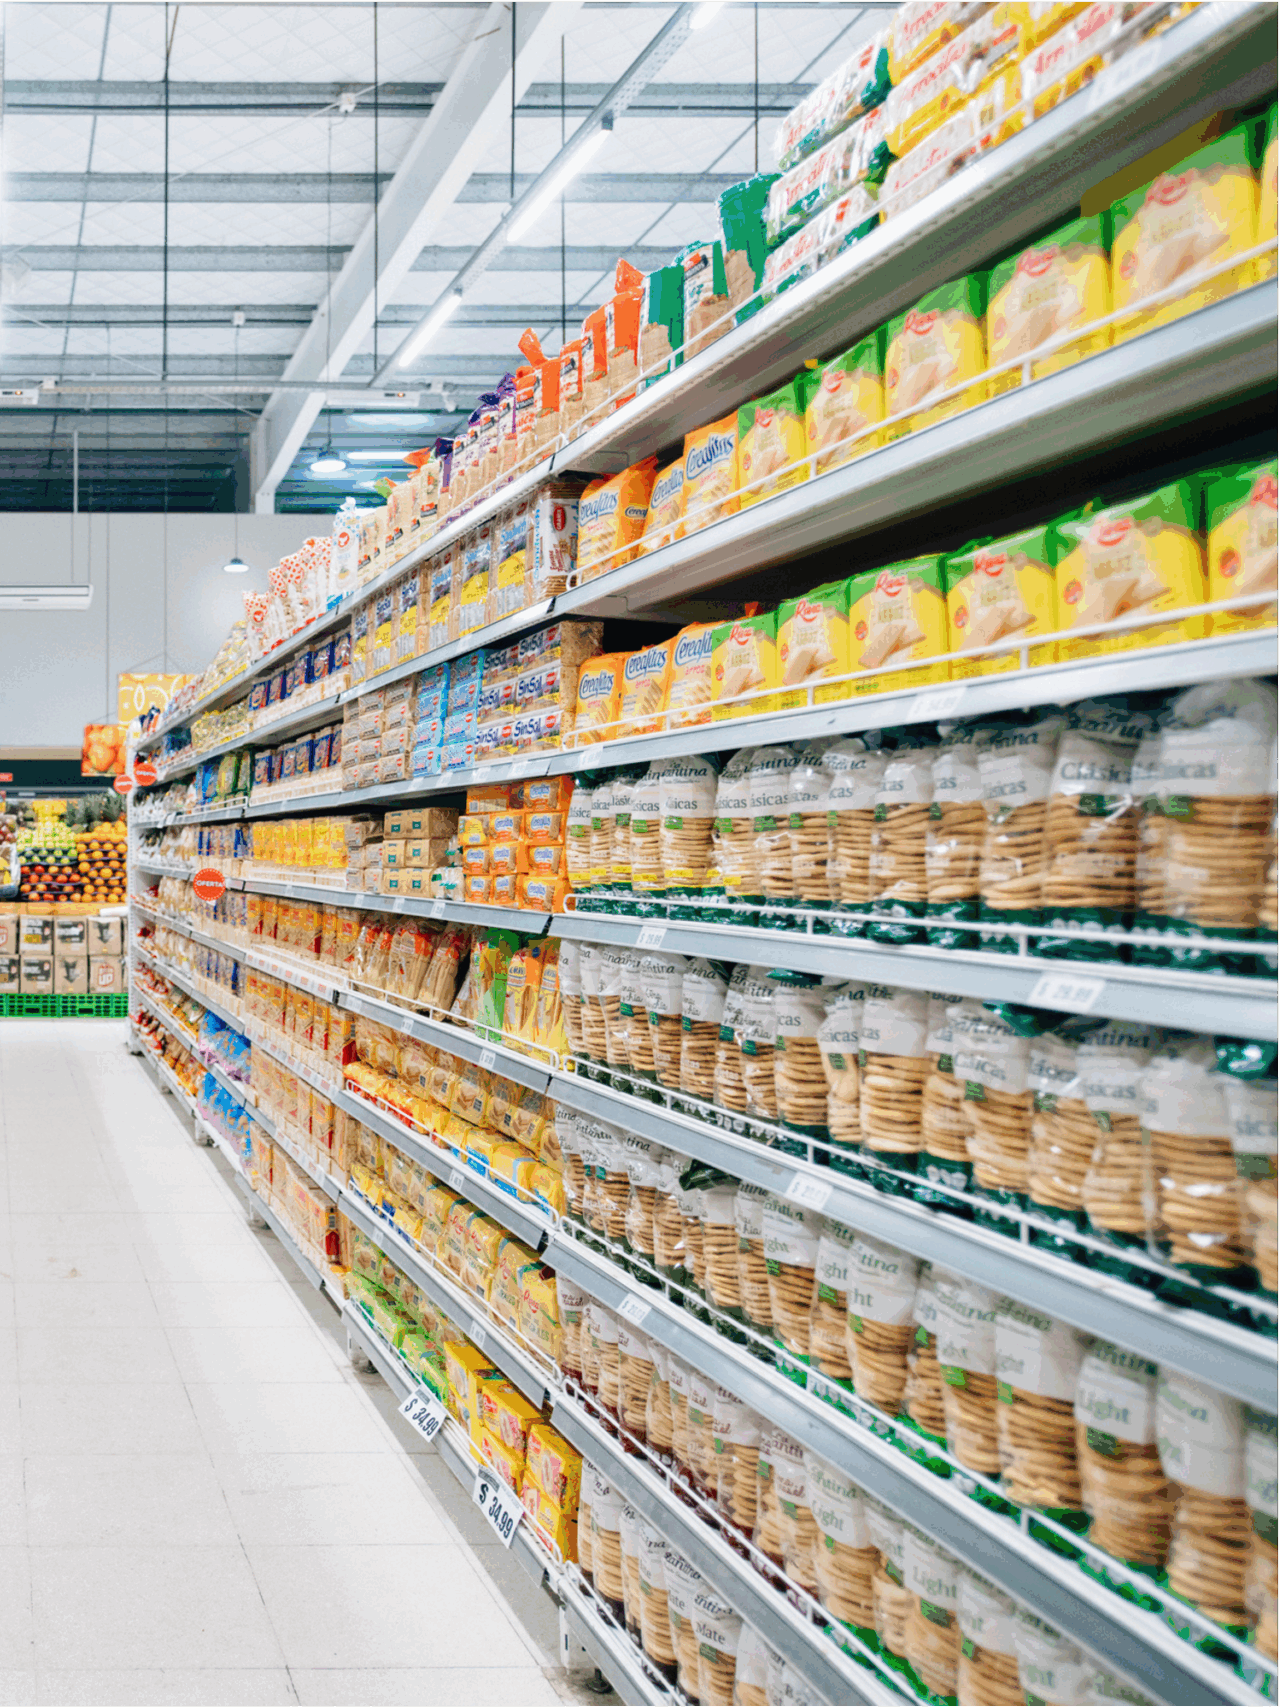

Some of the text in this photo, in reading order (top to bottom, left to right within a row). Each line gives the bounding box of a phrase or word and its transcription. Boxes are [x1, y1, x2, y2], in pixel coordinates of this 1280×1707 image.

[625, 648, 668, 680] Cerealitas
[517, 675, 543, 697] SinSal
[513, 717, 542, 737] SinSal
[750, 793, 789, 808] ásicas
[764, 1236, 790, 1254] ight
[860, 1253, 899, 1275] tina
[404, 1397, 439, 1437] $ 34.99
[479, 1483, 489, 1504] $
[488, 1496, 514, 1539] 34.99
[695, 1621, 726, 1645] Mate
